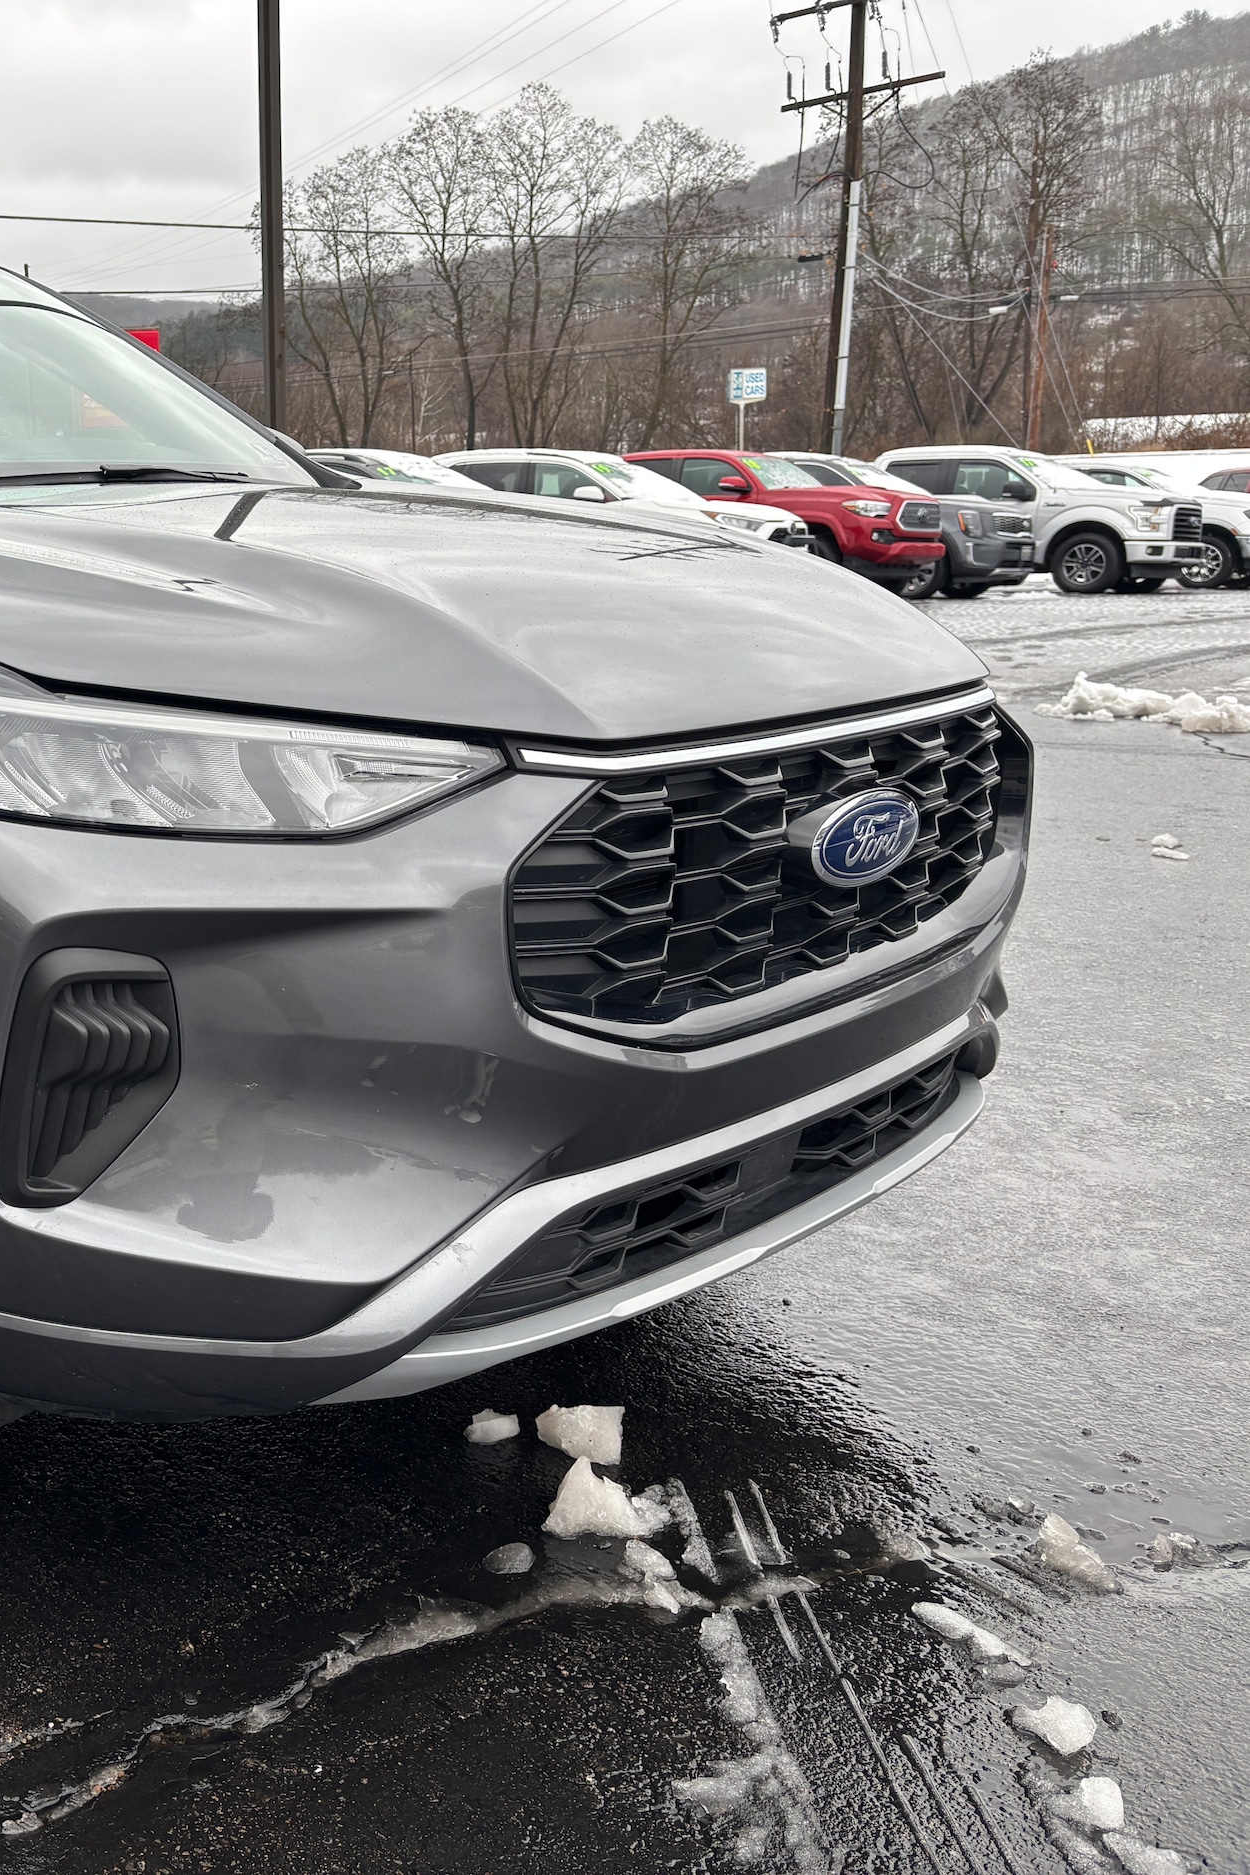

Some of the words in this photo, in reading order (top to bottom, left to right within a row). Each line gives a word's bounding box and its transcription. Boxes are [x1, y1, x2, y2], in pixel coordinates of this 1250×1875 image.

[745, 372, 765, 384] USED
[744, 384, 765, 396] CARS
[844, 811, 904, 868] Ford
